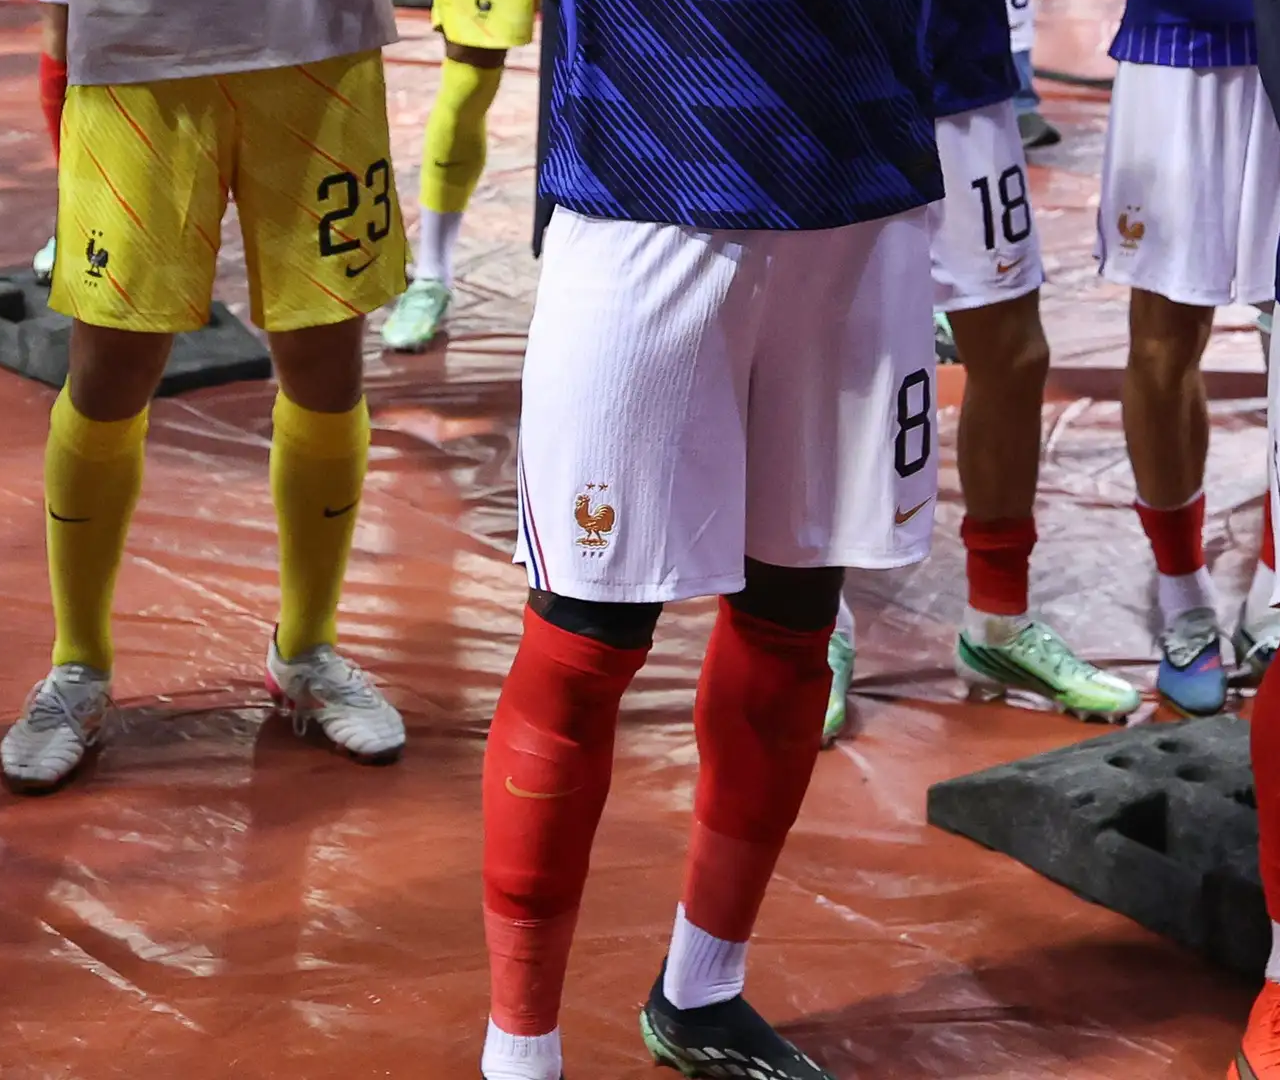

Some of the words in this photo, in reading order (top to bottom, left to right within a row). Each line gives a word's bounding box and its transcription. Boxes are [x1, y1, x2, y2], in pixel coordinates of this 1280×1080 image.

[317, 158, 390, 257] 23
[971, 164, 1031, 250] 18
[894, 368, 930, 478] 8
